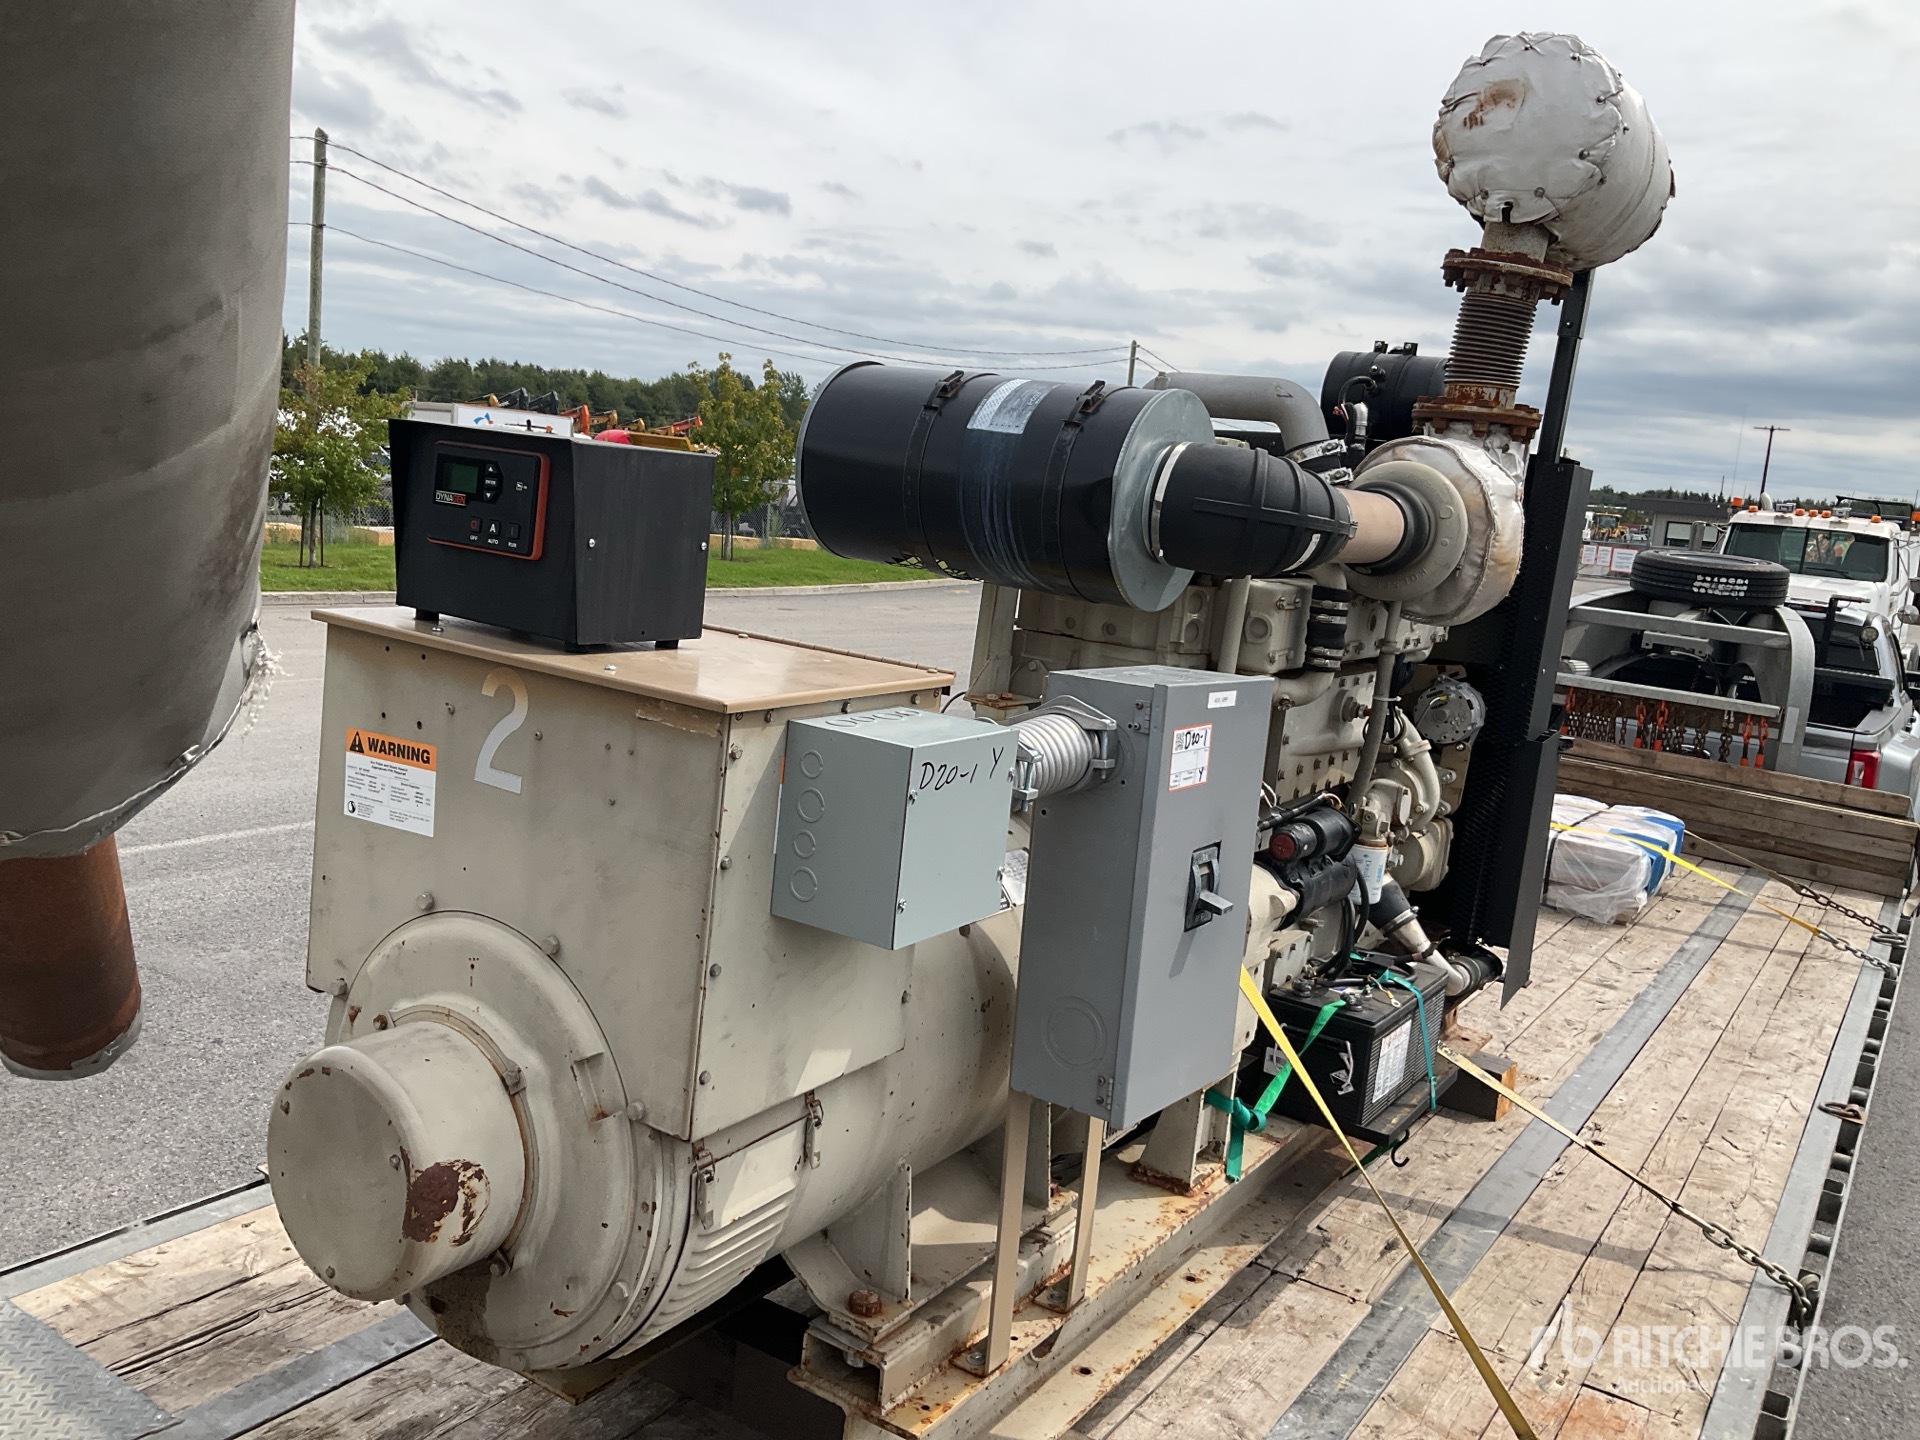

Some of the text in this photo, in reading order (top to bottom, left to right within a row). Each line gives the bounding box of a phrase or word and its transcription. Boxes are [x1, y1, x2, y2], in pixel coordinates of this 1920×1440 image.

[435, 492, 466, 505] DYNAGEN
[489, 523, 496, 533] A
[474, 667, 529, 795] 2
[1184, 729, 1208, 750] D20-1
[367, 736, 431, 765] WARNING
[919, 747, 1004, 791] D20-1 Y
[1198, 766, 1205, 782] Y
